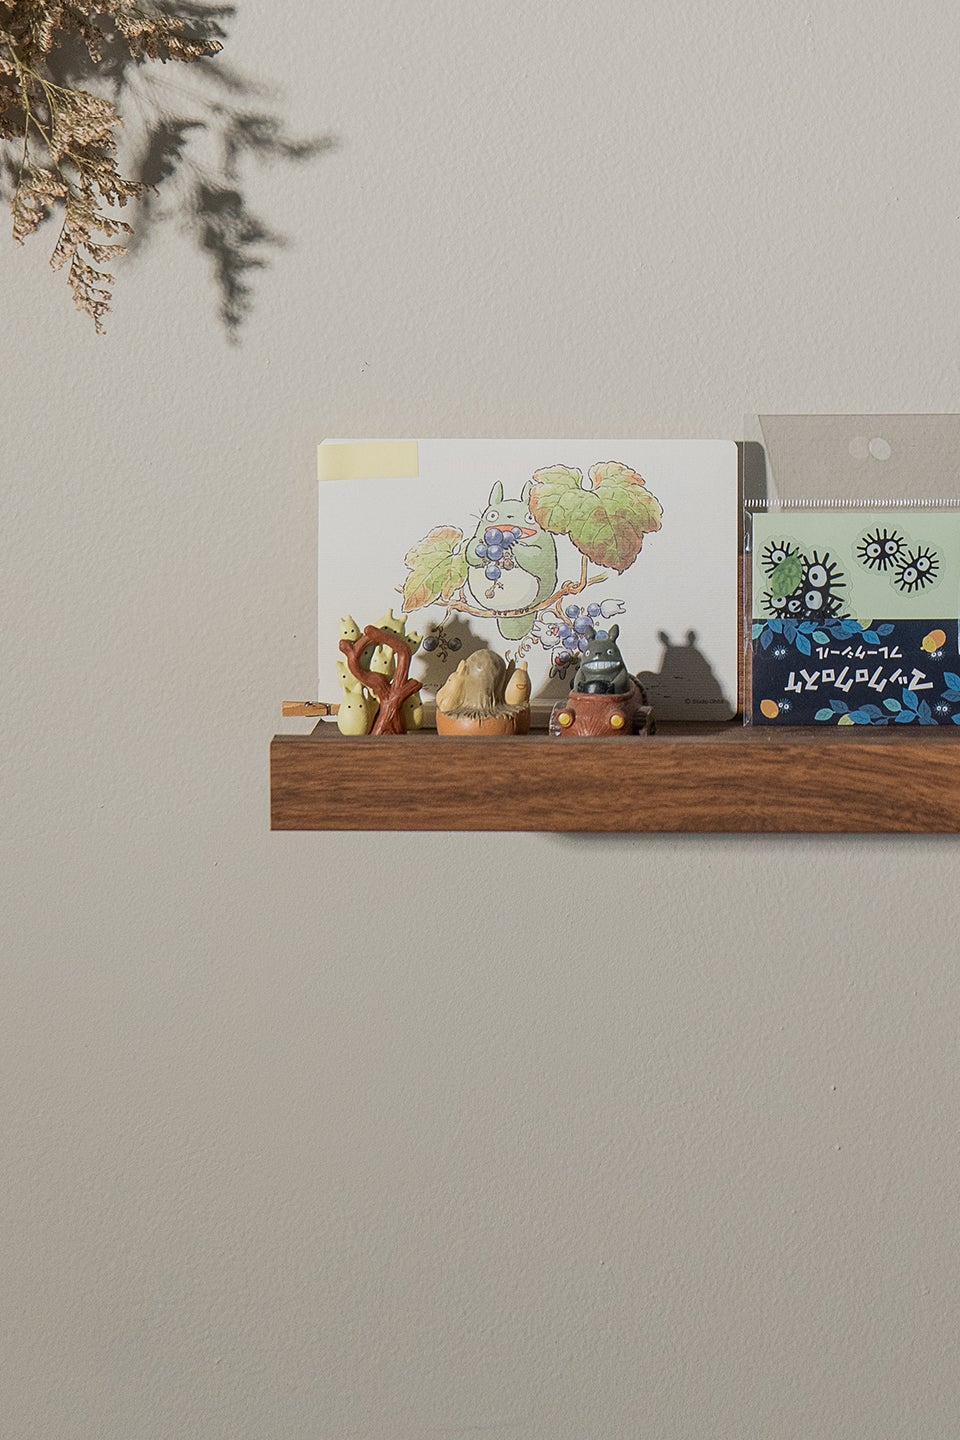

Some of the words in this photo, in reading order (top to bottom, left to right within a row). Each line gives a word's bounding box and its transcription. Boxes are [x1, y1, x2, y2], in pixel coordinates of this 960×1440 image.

[815, 646, 902, 659] フレークシール
[784, 666, 934, 694] マックロクロスケ
